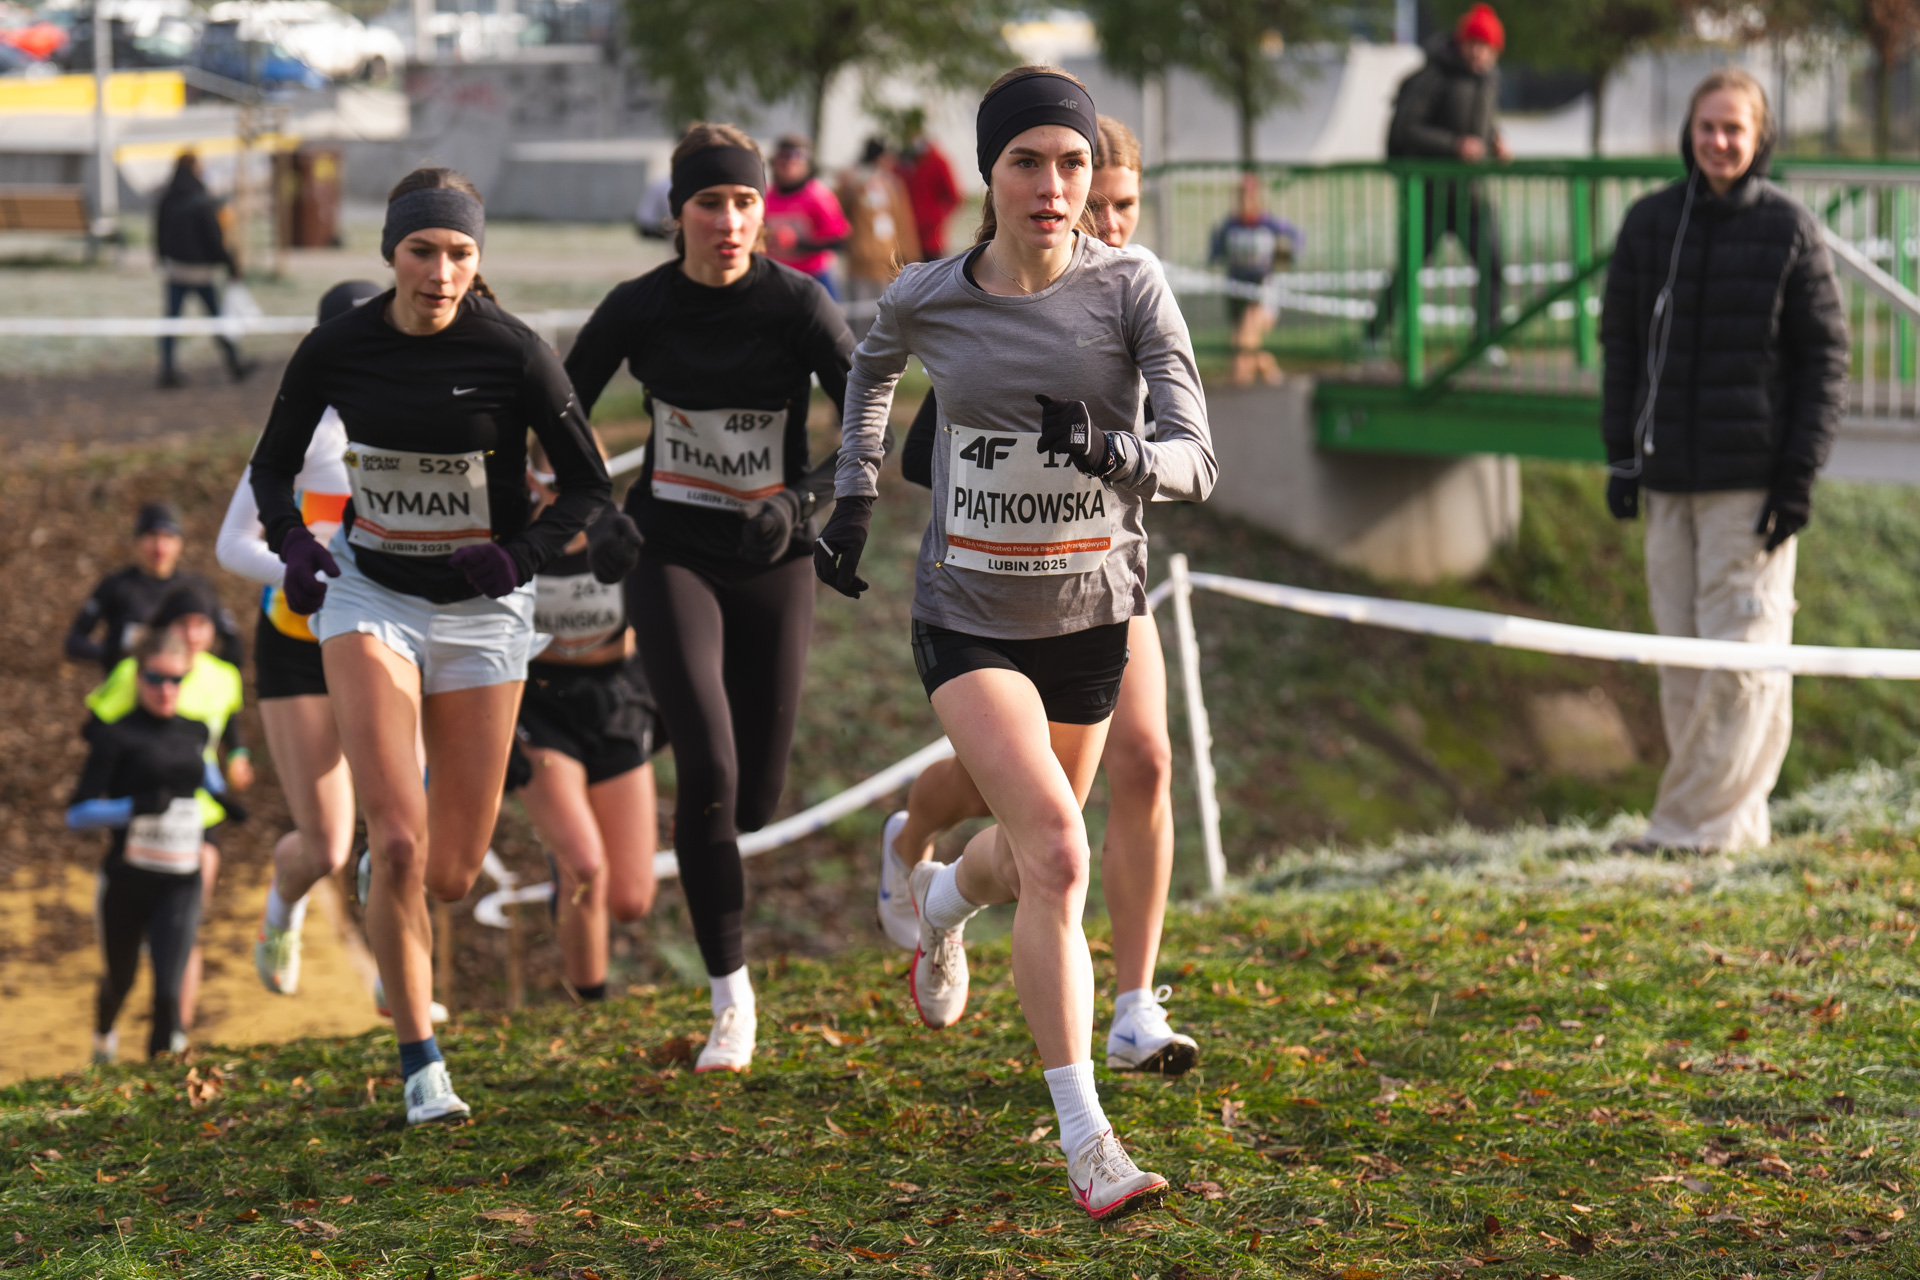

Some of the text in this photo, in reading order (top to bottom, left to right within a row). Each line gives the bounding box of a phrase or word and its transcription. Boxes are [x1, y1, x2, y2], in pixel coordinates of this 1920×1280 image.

[1058, 99, 1078, 110] 4F
[725, 413, 773, 433] 489
[665, 438, 771, 477] THAMM
[959, 435, 1017, 470] 4F
[419, 458, 470, 475] 529
[361, 487, 470, 516] TYMAN
[687, 490, 721, 504] LUBIN
[954, 487, 1105, 528] PIĄTKOWSKA
[382, 542, 452, 553] LUBIN 2025
[988, 558, 1067, 571] LUBIN 2025
